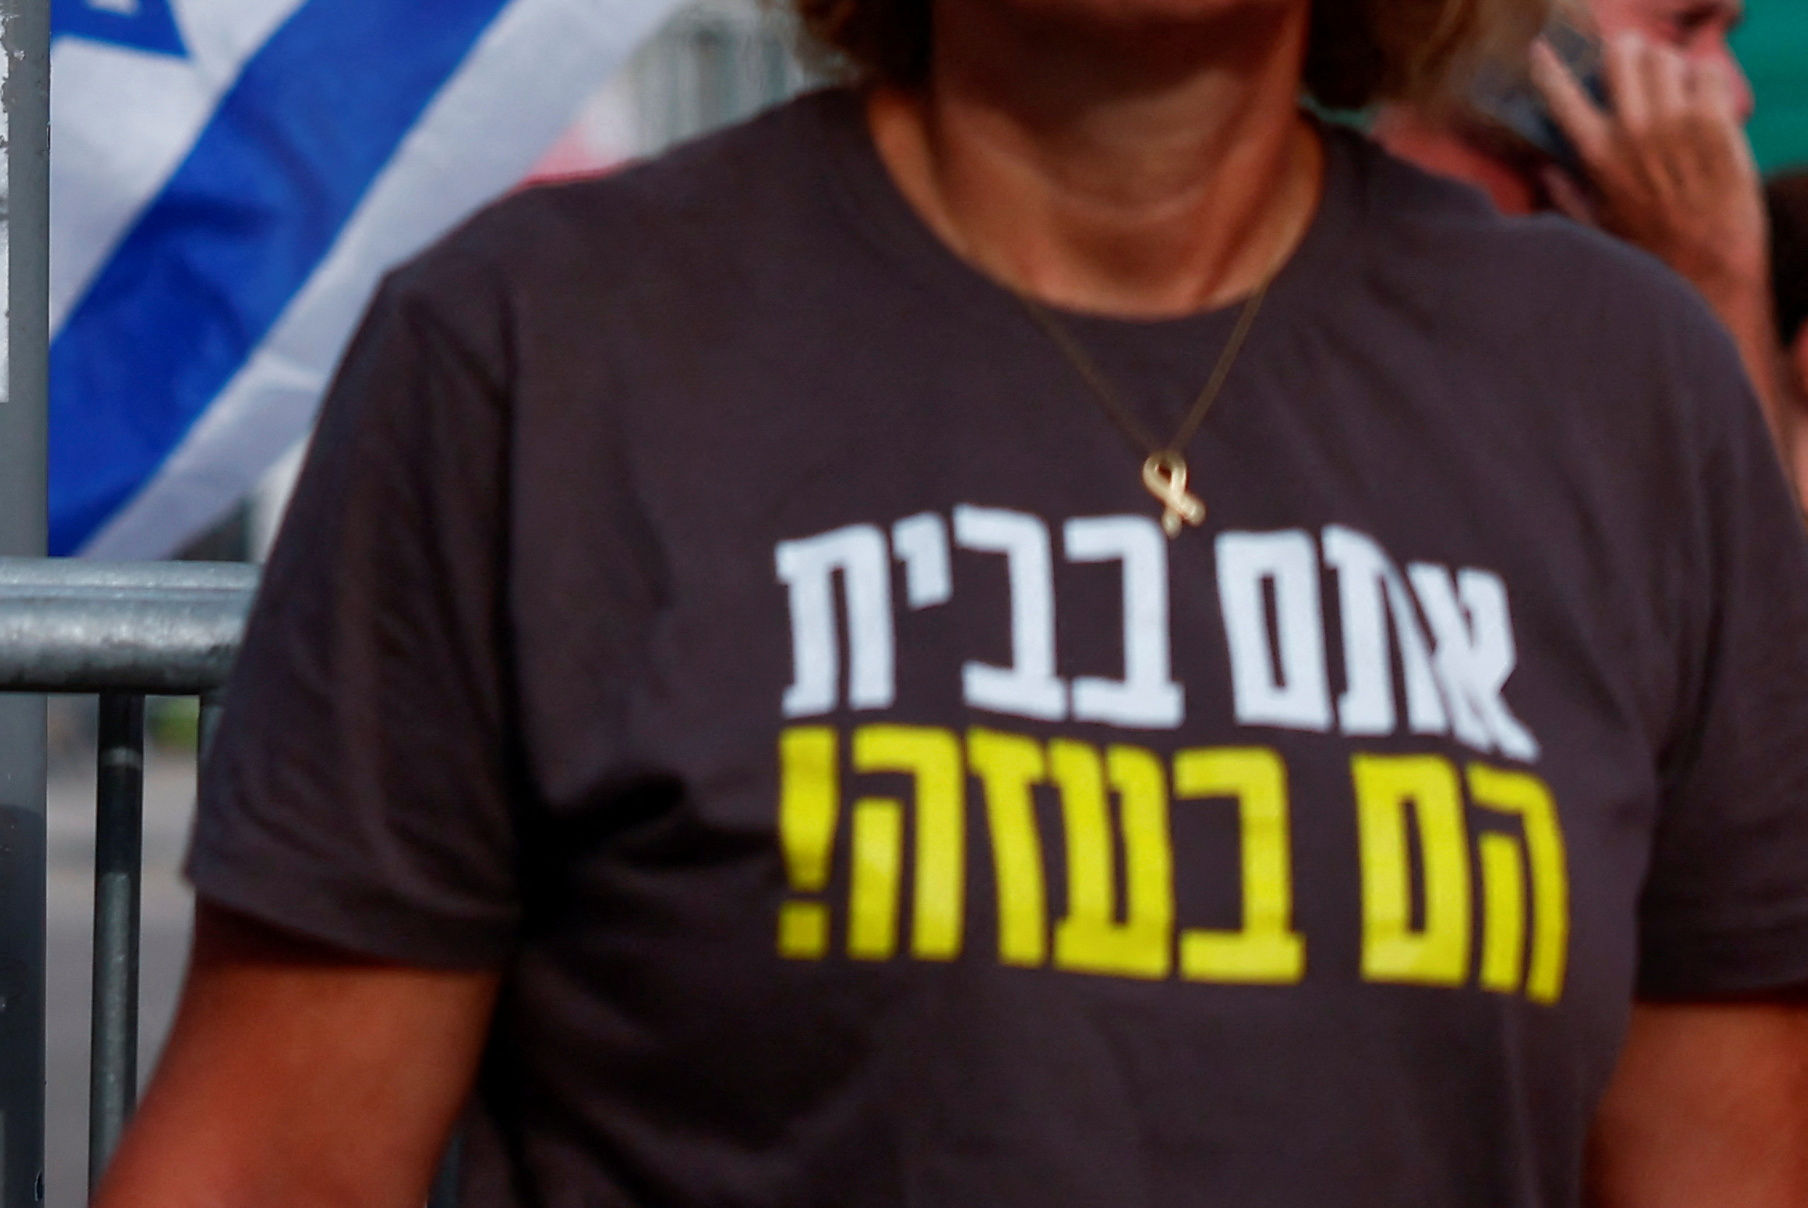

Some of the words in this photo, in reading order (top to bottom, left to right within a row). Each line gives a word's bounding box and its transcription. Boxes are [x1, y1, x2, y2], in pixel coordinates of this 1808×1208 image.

[774, 503, 1185, 728] בבית
[1214, 523, 1542, 763] אתם
[776, 721, 1307, 982] בעזה!
[1349, 752, 1571, 1007] הם
